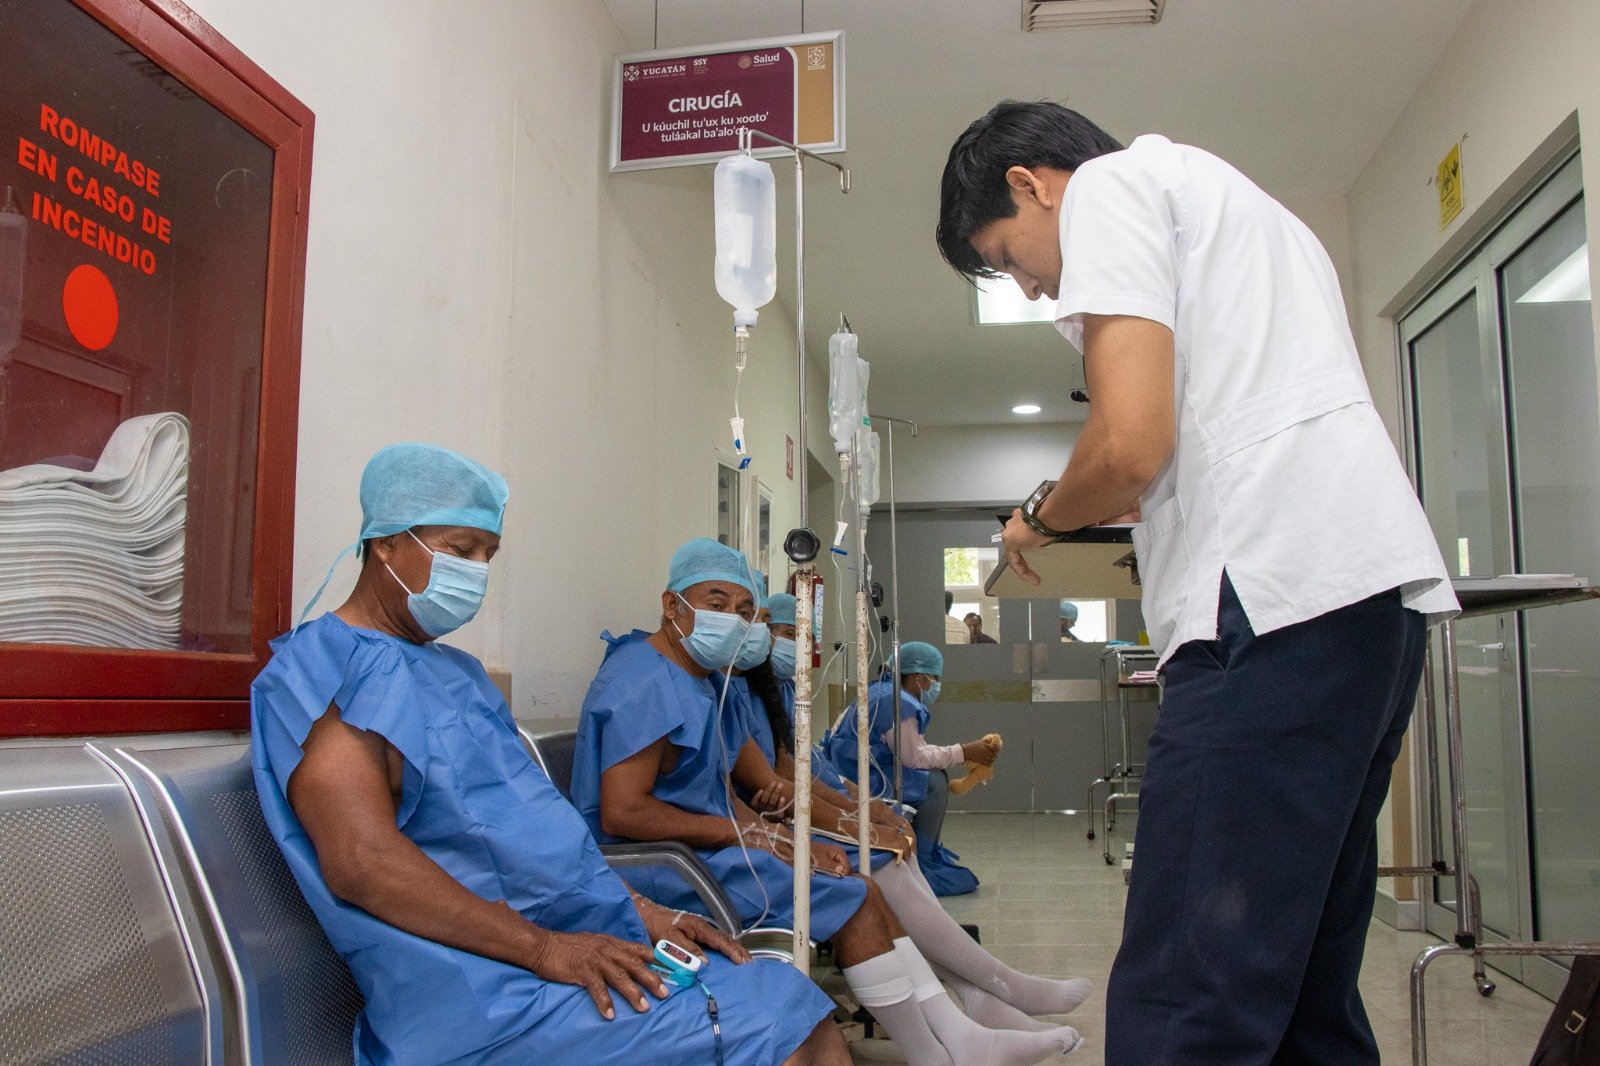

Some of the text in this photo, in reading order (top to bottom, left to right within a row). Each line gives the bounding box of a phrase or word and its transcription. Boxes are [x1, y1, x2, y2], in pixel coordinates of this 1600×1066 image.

[693, 58, 708, 67] SSY
[753, 53, 780, 64] Salud
[643, 65, 686, 76] YUCATÁN
[668, 90, 743, 113] CIRUGÍA
[642, 123, 651, 133] U
[653, 119, 690, 132] kúuchil
[720, 116, 734, 126] ku
[661, 128, 701, 142] tuláakal
[41, 104, 160, 197] ROMPASE
[19, 138, 171, 244] EN CASO DE
[32, 192, 156, 276] INCENDIO
